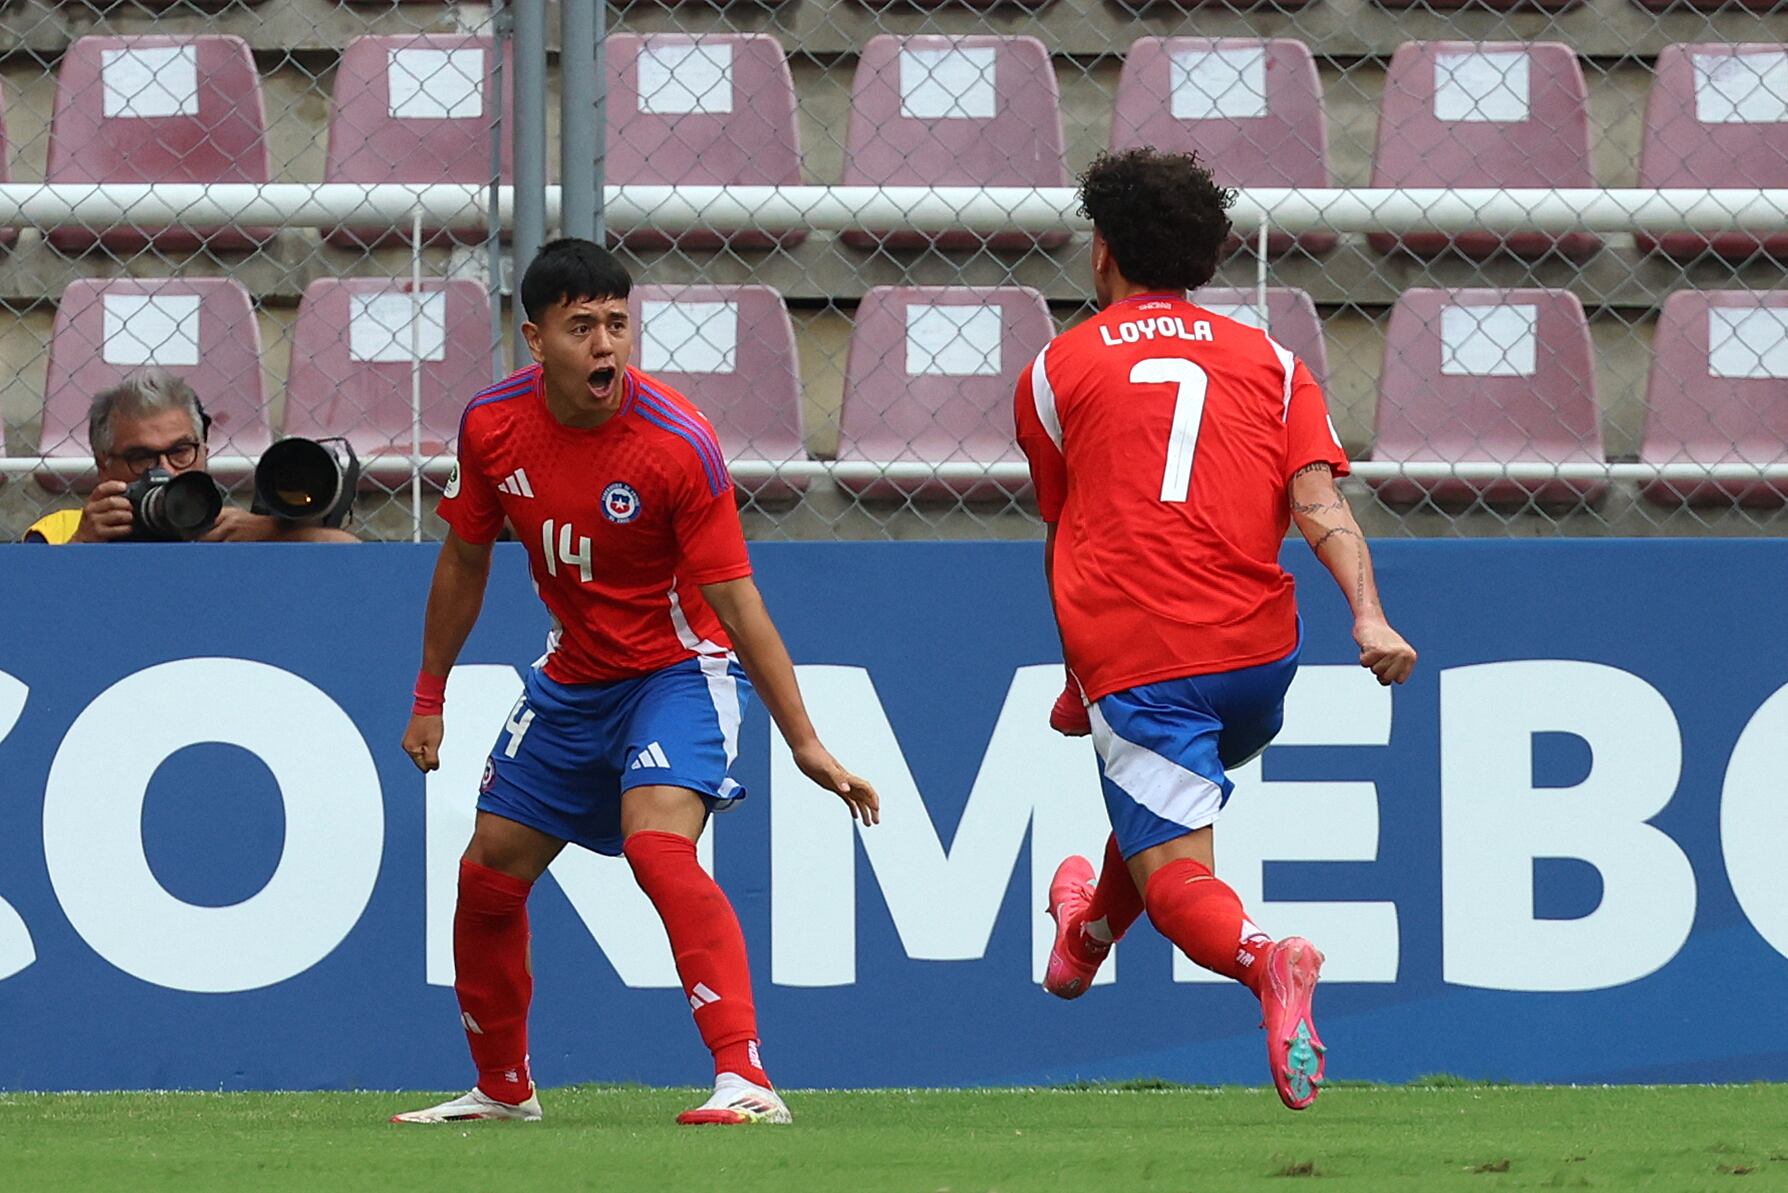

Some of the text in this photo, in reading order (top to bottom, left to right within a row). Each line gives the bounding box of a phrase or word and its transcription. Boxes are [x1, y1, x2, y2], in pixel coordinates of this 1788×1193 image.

[1099, 315, 1214, 346] LOYOLA
[1129, 357, 1208, 503] 7
[542, 519, 593, 583] 14
[0, 657, 1788, 992] OMEB
